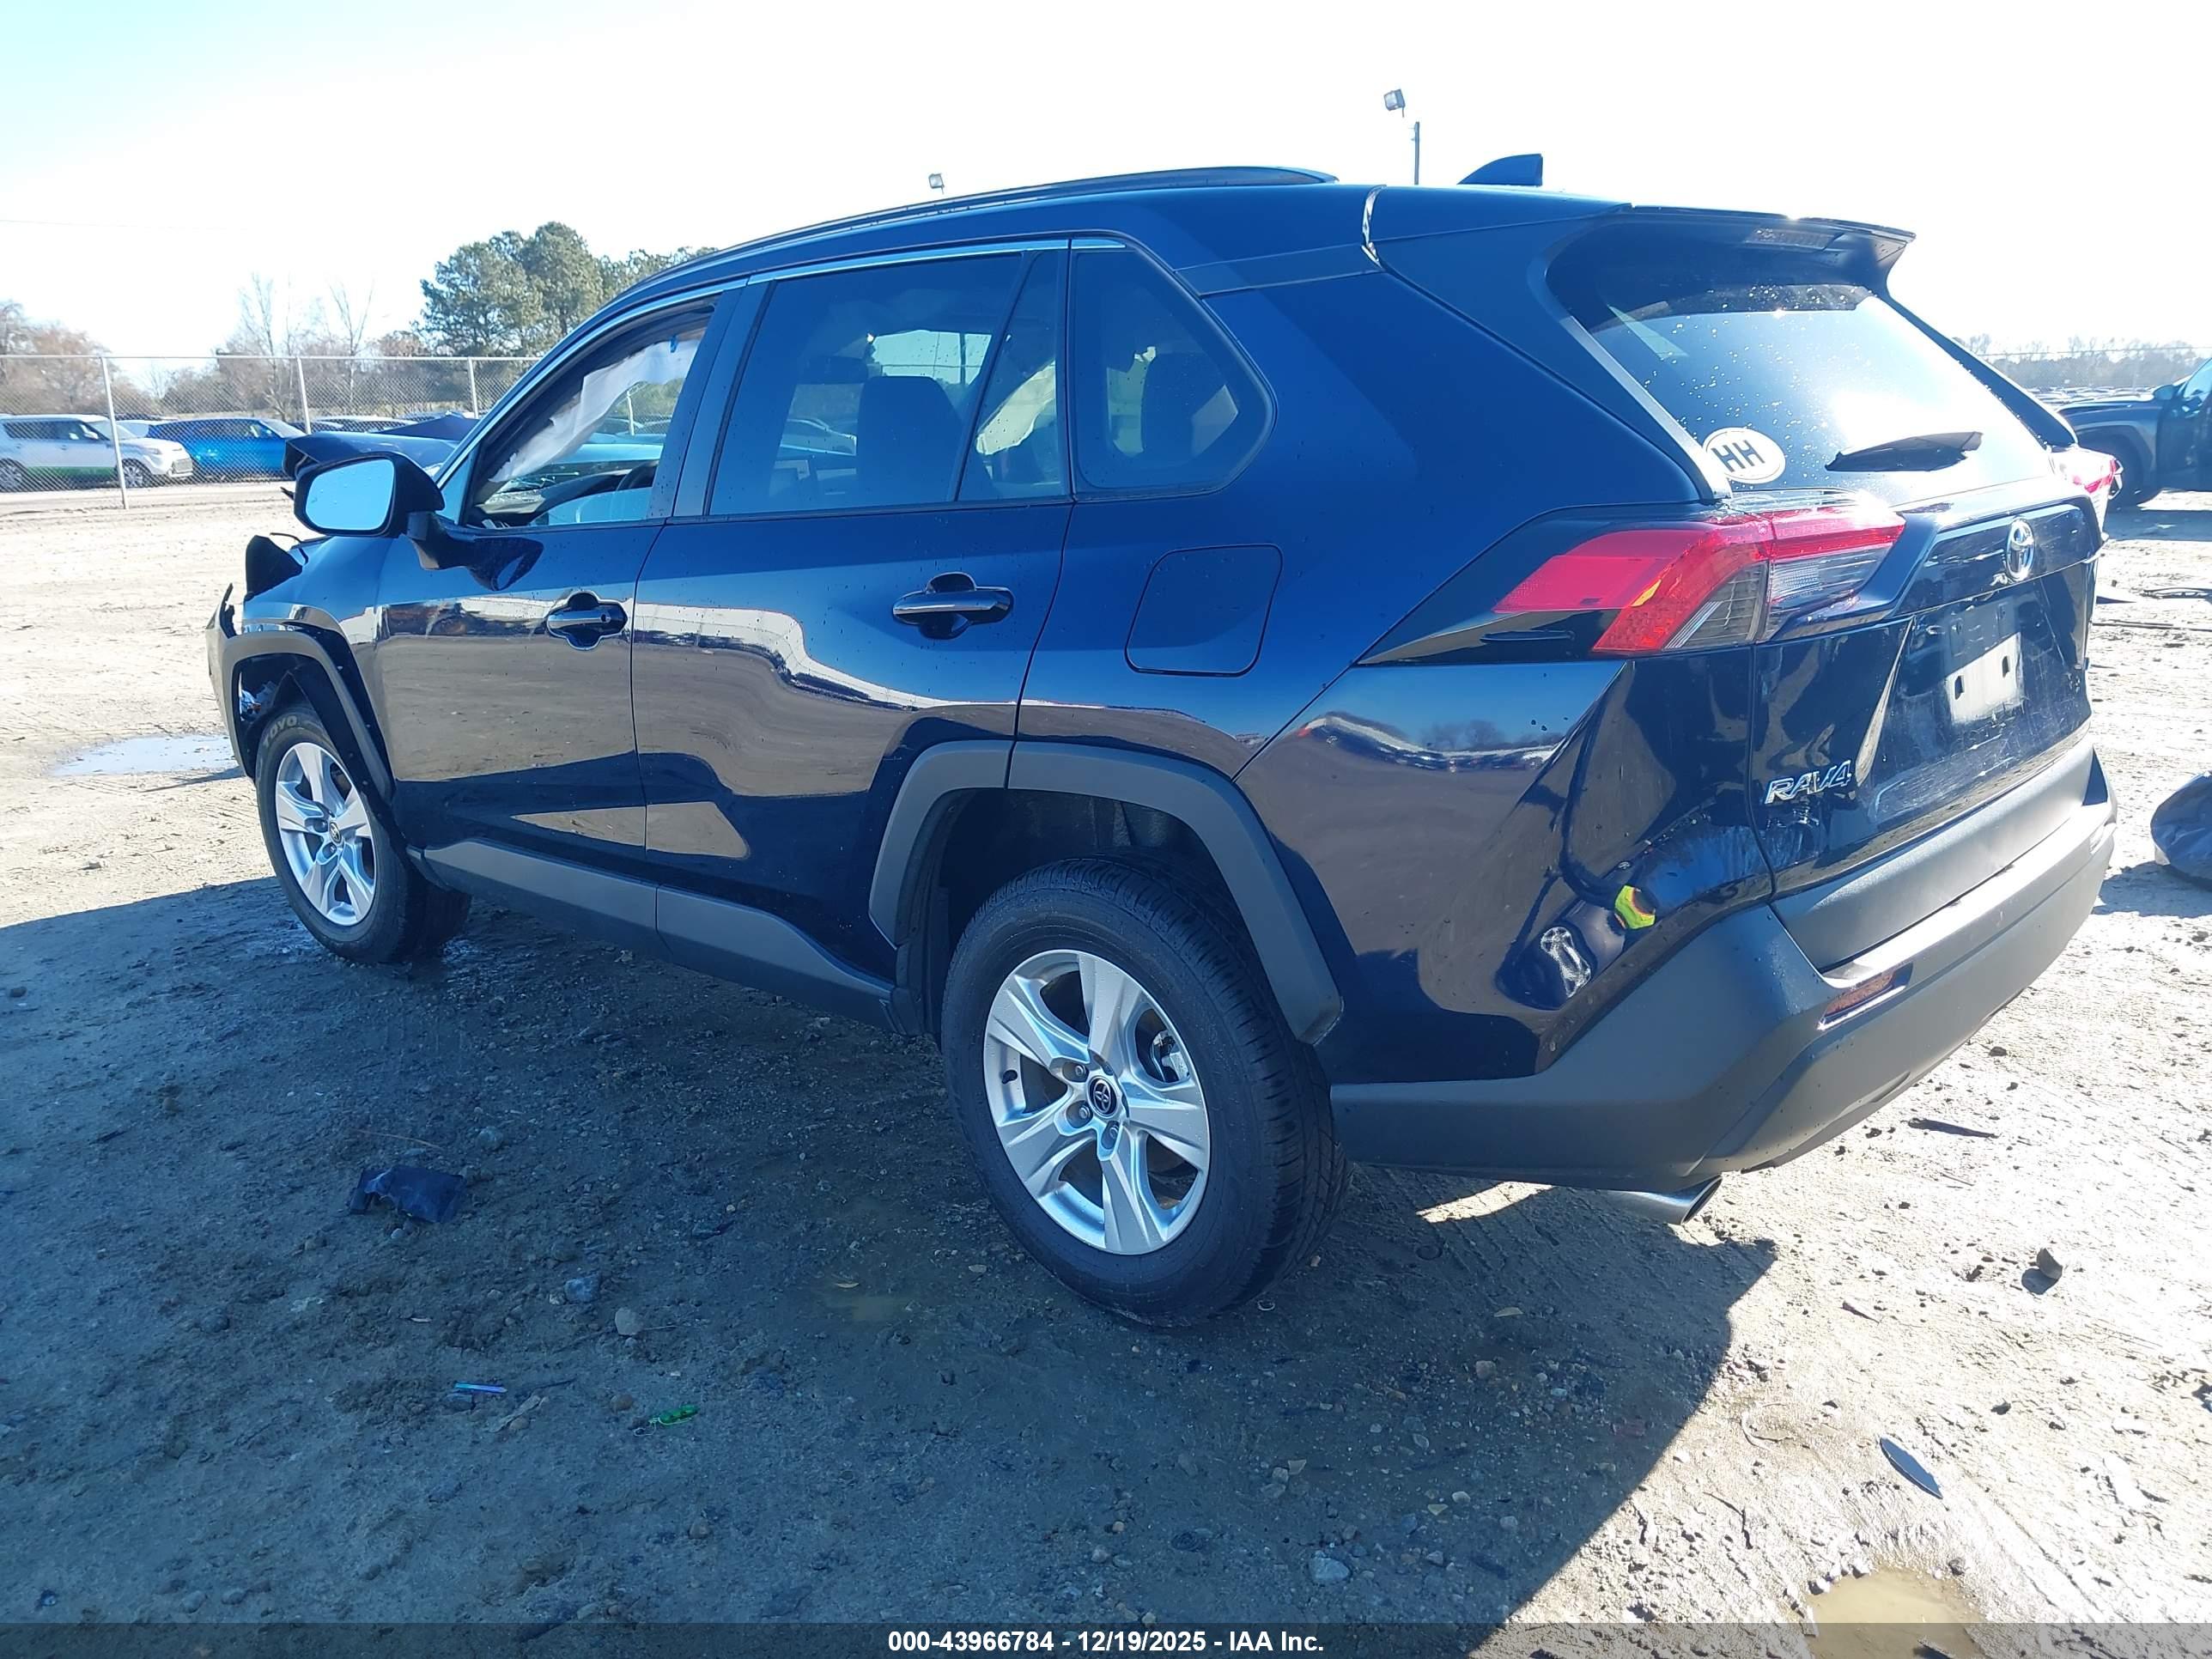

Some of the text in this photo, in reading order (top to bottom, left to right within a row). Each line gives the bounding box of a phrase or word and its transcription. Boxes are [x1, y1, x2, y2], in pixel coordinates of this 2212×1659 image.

[1711, 440, 1765, 472] HH
[263, 715, 297, 748] TOYO
[1764, 760, 1852, 805] RAV4
